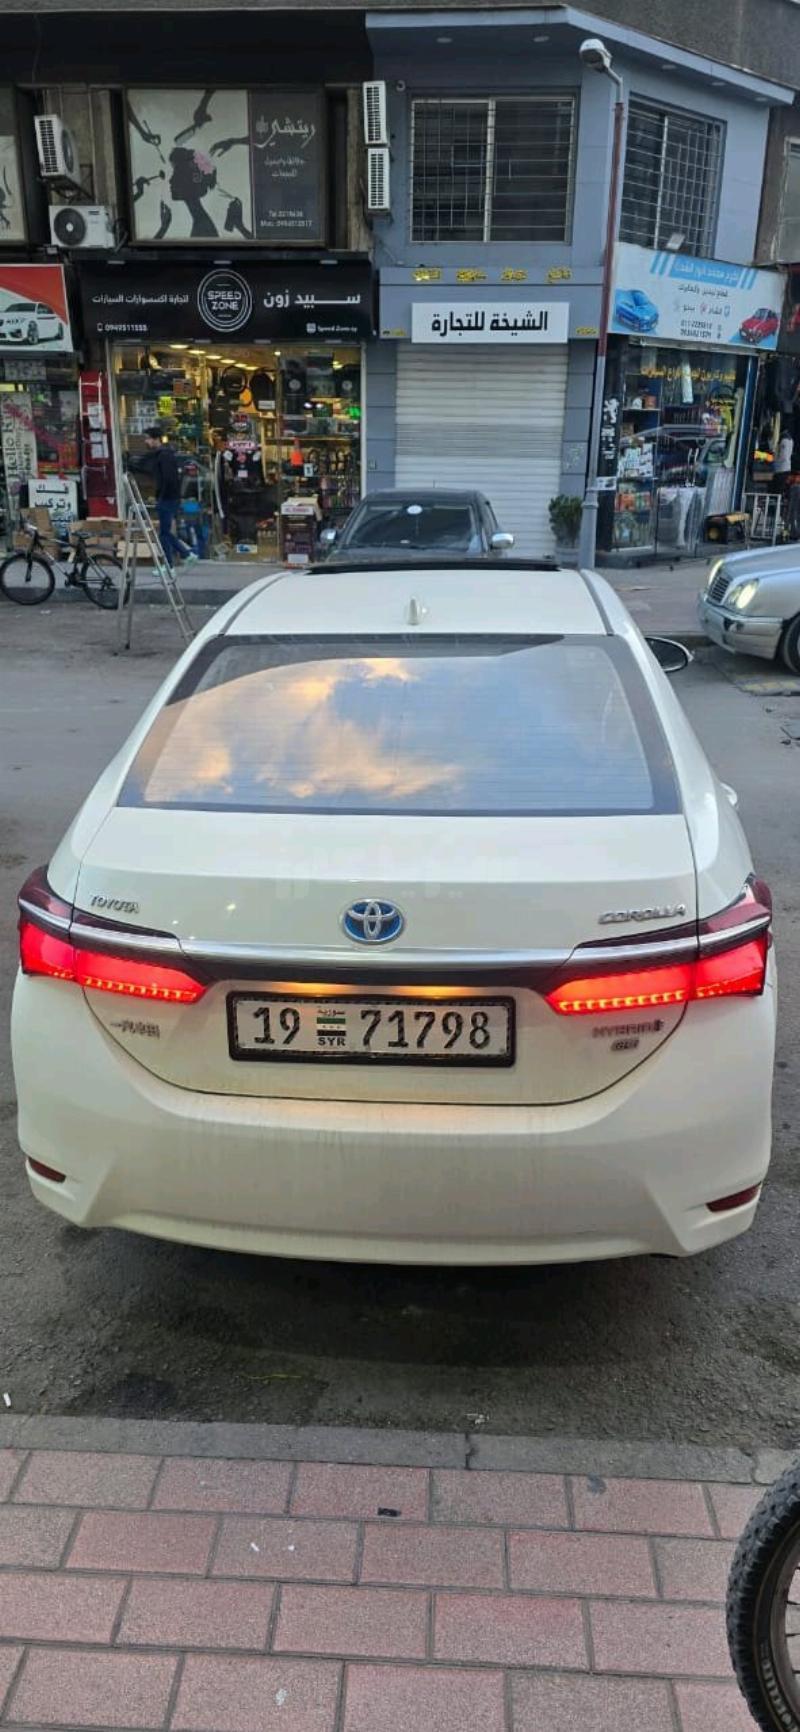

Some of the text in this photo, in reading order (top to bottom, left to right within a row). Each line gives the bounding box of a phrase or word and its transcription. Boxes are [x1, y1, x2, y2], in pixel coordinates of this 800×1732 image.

[207, 290, 242, 300] SPEED
[263, 289, 289, 308] زون
[211, 301, 239, 310] ZONE
[431, 310, 548, 337] الشيخة للتجارة
[90, 894, 138, 914] TOYOTA
[597, 904, 687, 925] COROLLA
[253, 1007, 301, 1045] 19
[360, 1010, 491, 1049] 71798
[318, 1037, 346, 1047] SYR
